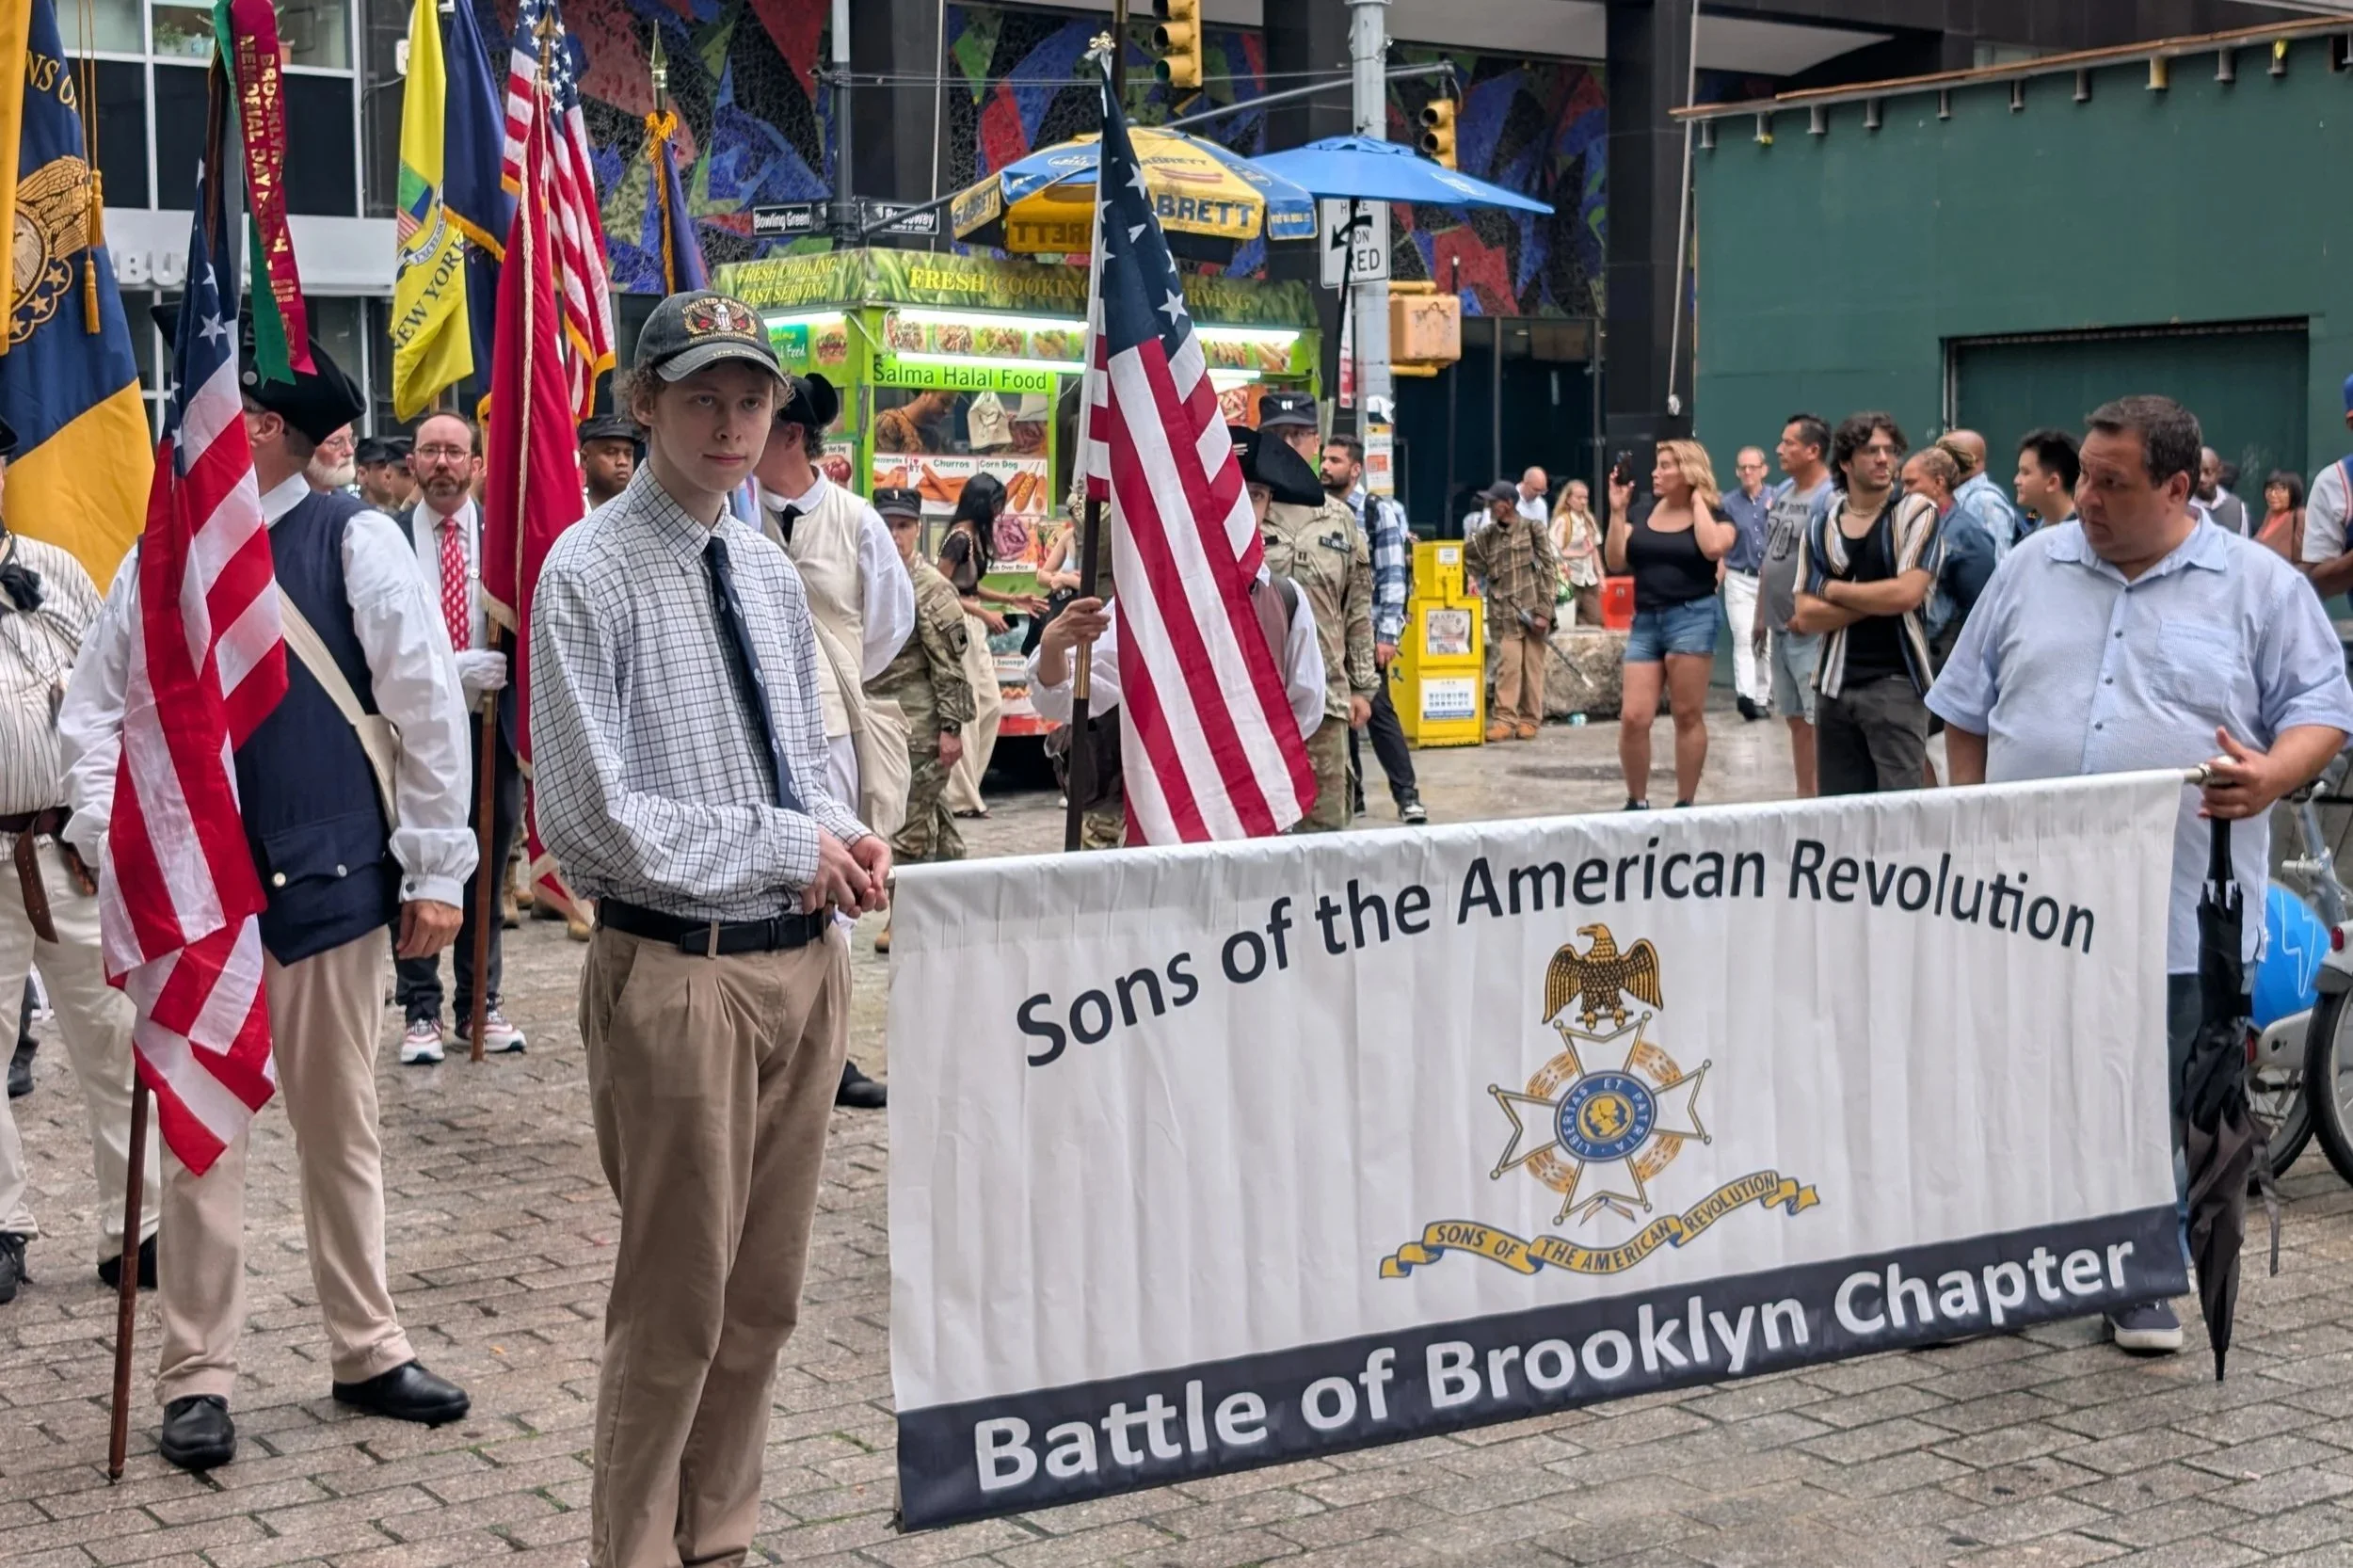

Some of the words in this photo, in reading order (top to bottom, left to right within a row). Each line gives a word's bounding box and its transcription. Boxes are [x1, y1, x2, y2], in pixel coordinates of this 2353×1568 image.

[250, 148, 271, 186] DAY
[755, 213, 786, 232] Bowling
[787, 212, 810, 228] Green
[1157, 194, 1254, 227] BRETT
[1353, 231, 1369, 245] ON
[737, 267, 777, 284] FRESH
[778, 258, 838, 280] COOKING
[909, 269, 986, 293] FRESH
[742, 288, 774, 303] FAST
[774, 281, 828, 302] SERVING
[1189, 286, 1252, 311] RVING
[681, 297, 718, 314] UNITED
[872, 361, 935, 385] Salma
[943, 365, 993, 387] Halal
[1001, 369, 1047, 390] Food
[933, 458, 970, 469] Churros
[980, 459, 1000, 469] Corn
[1001, 460, 1018, 470] Dog
[1016, 952, 1199, 1067] Sons
[1220, 896, 1291, 984] of
[1315, 878, 1431, 956] the
[1456, 837, 1766, 925] American
[1788, 839, 2095, 953] Revolution
[1562, 1086, 1591, 1155] LIBERTAS
[1614, 1092, 1649, 1152] PATRIA
[1436, 1225, 1487, 1248] SONS
[1494, 1238, 1520, 1258] OF
[1541, 1239, 1577, 1266] THE
[1580, 1218, 1672, 1272] AMERICAN
[1686, 1173, 1776, 1233] REVOLUTION
[974, 1379, 1268, 1493] Battle
[1301, 1348, 1396, 1430] of
[1424, 1295, 1810, 1410] Brooklyn
[1834, 1236, 2134, 1334] Chapter
